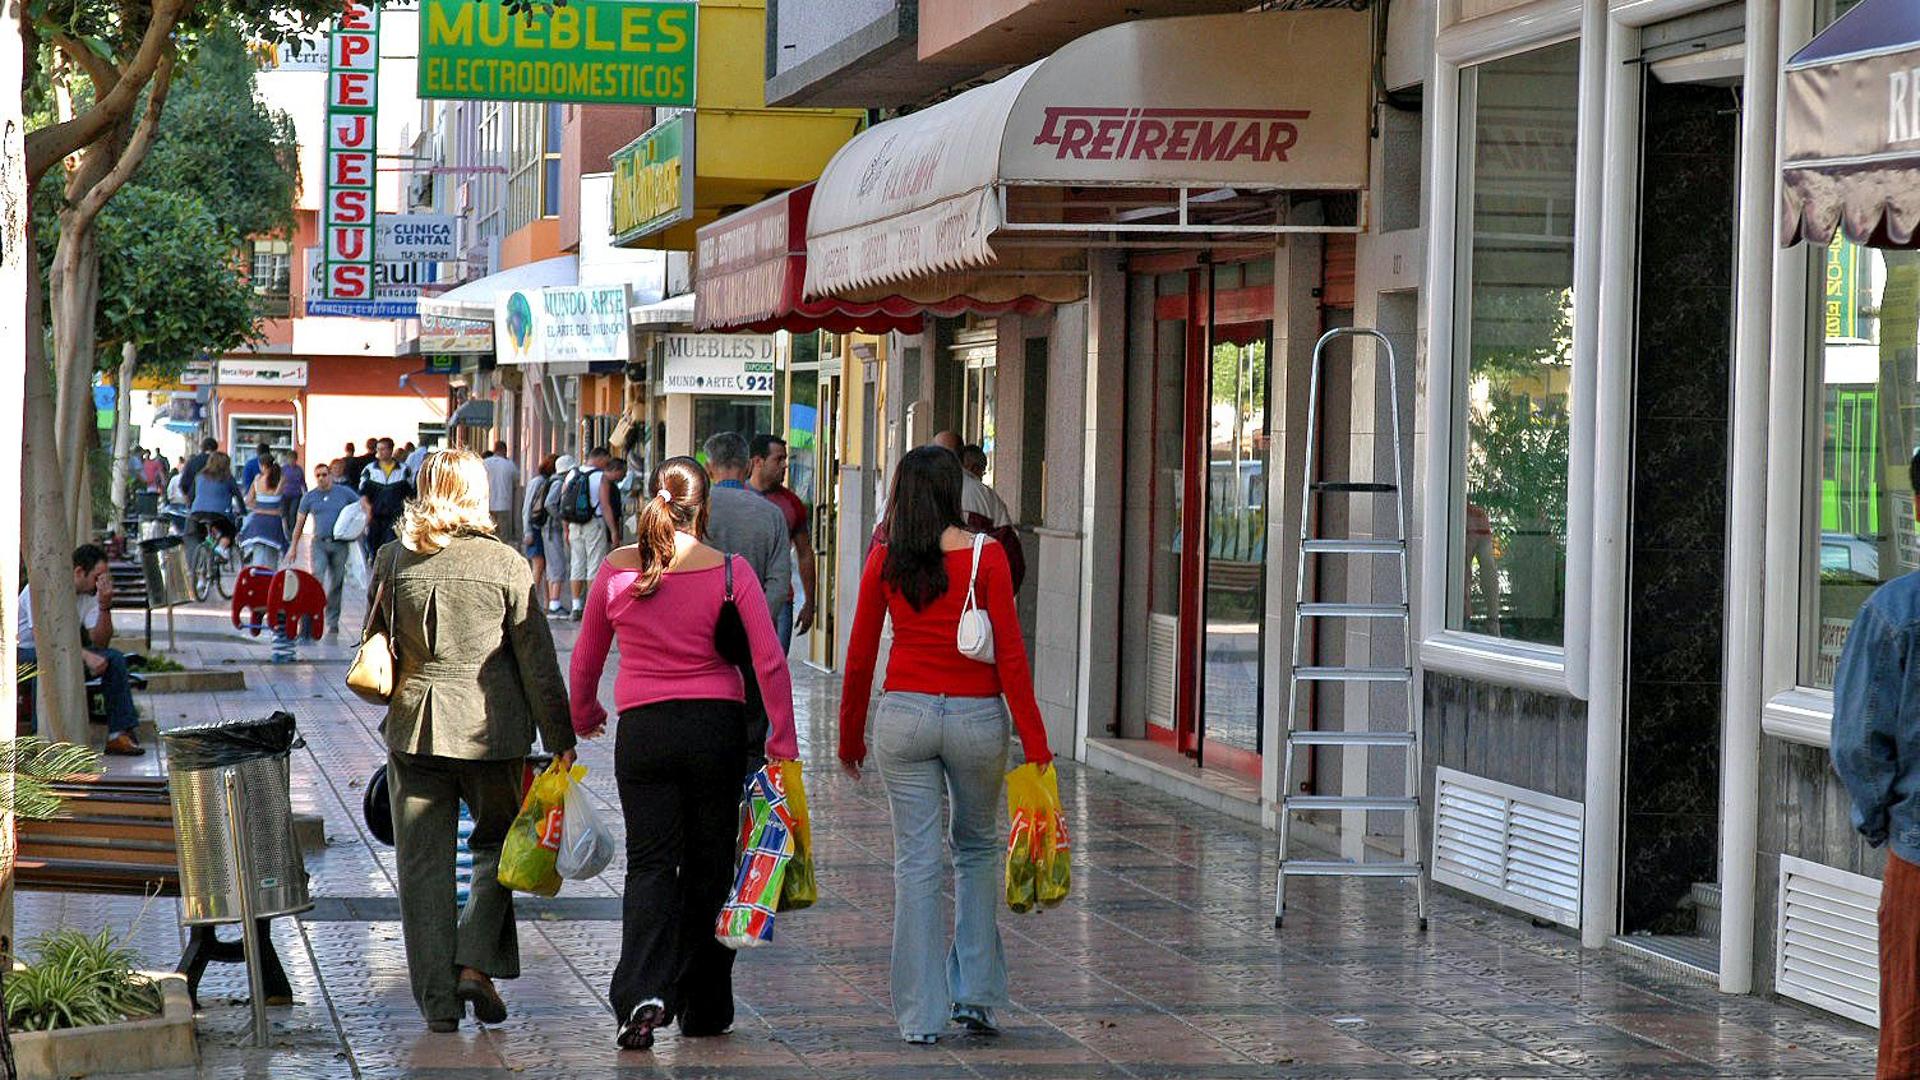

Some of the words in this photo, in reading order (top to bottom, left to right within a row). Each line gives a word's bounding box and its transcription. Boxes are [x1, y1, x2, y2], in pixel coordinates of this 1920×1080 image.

[428, 1, 690, 53] MUEBLES
[427, 57, 686, 98] ELECTRODOMESTICOS
[394, 224, 450, 235] CLINICA
[395, 235, 452, 246] DENTAL
[544, 291, 587, 317] MUNDO
[591, 289, 624, 315] ARTE
[546, 326, 555, 337] EL
[556, 325, 575, 337] ARTE
[576, 324, 591, 337] DEL
[668, 337, 756, 359] MUEBLES
[706, 377, 734, 388] ARTE
